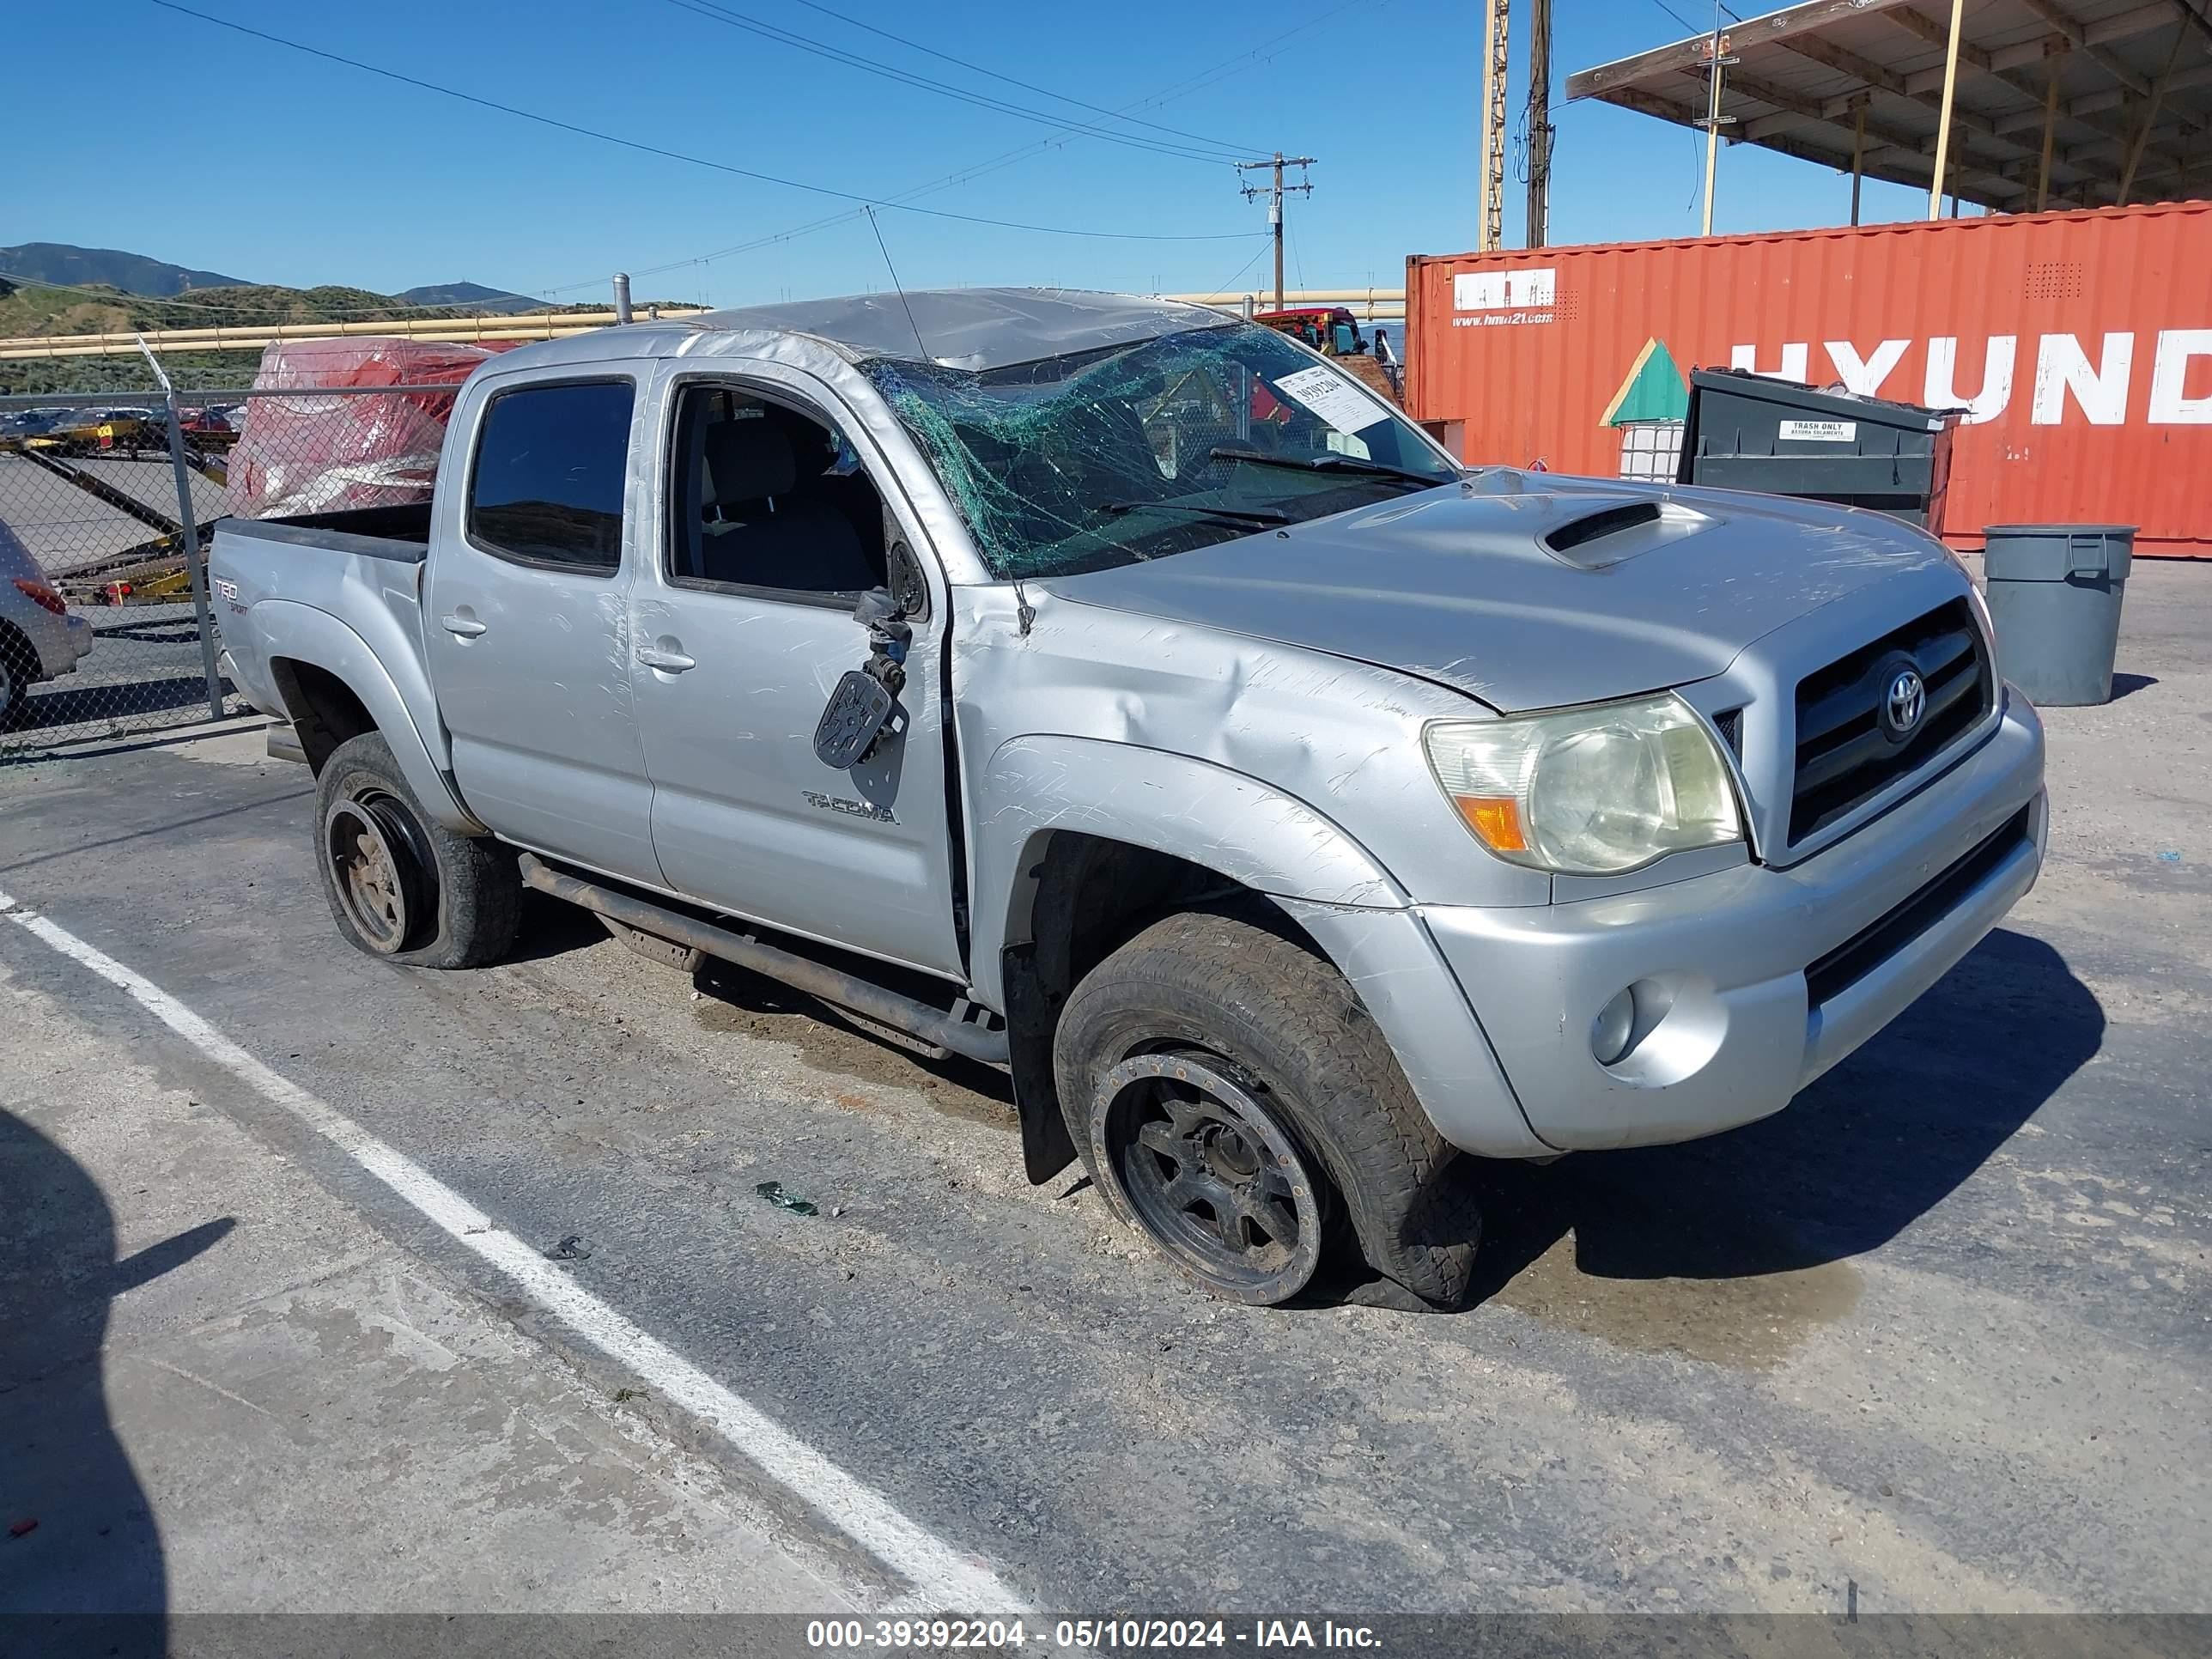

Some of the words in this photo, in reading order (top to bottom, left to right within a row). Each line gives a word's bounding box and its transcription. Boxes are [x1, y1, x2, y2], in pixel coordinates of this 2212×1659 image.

[1296, 378, 1344, 402] 39392204
[1794, 422, 1820, 430] TRASH
[215, 579, 238, 602] TRD
[801, 790, 901, 825] TACOMA
